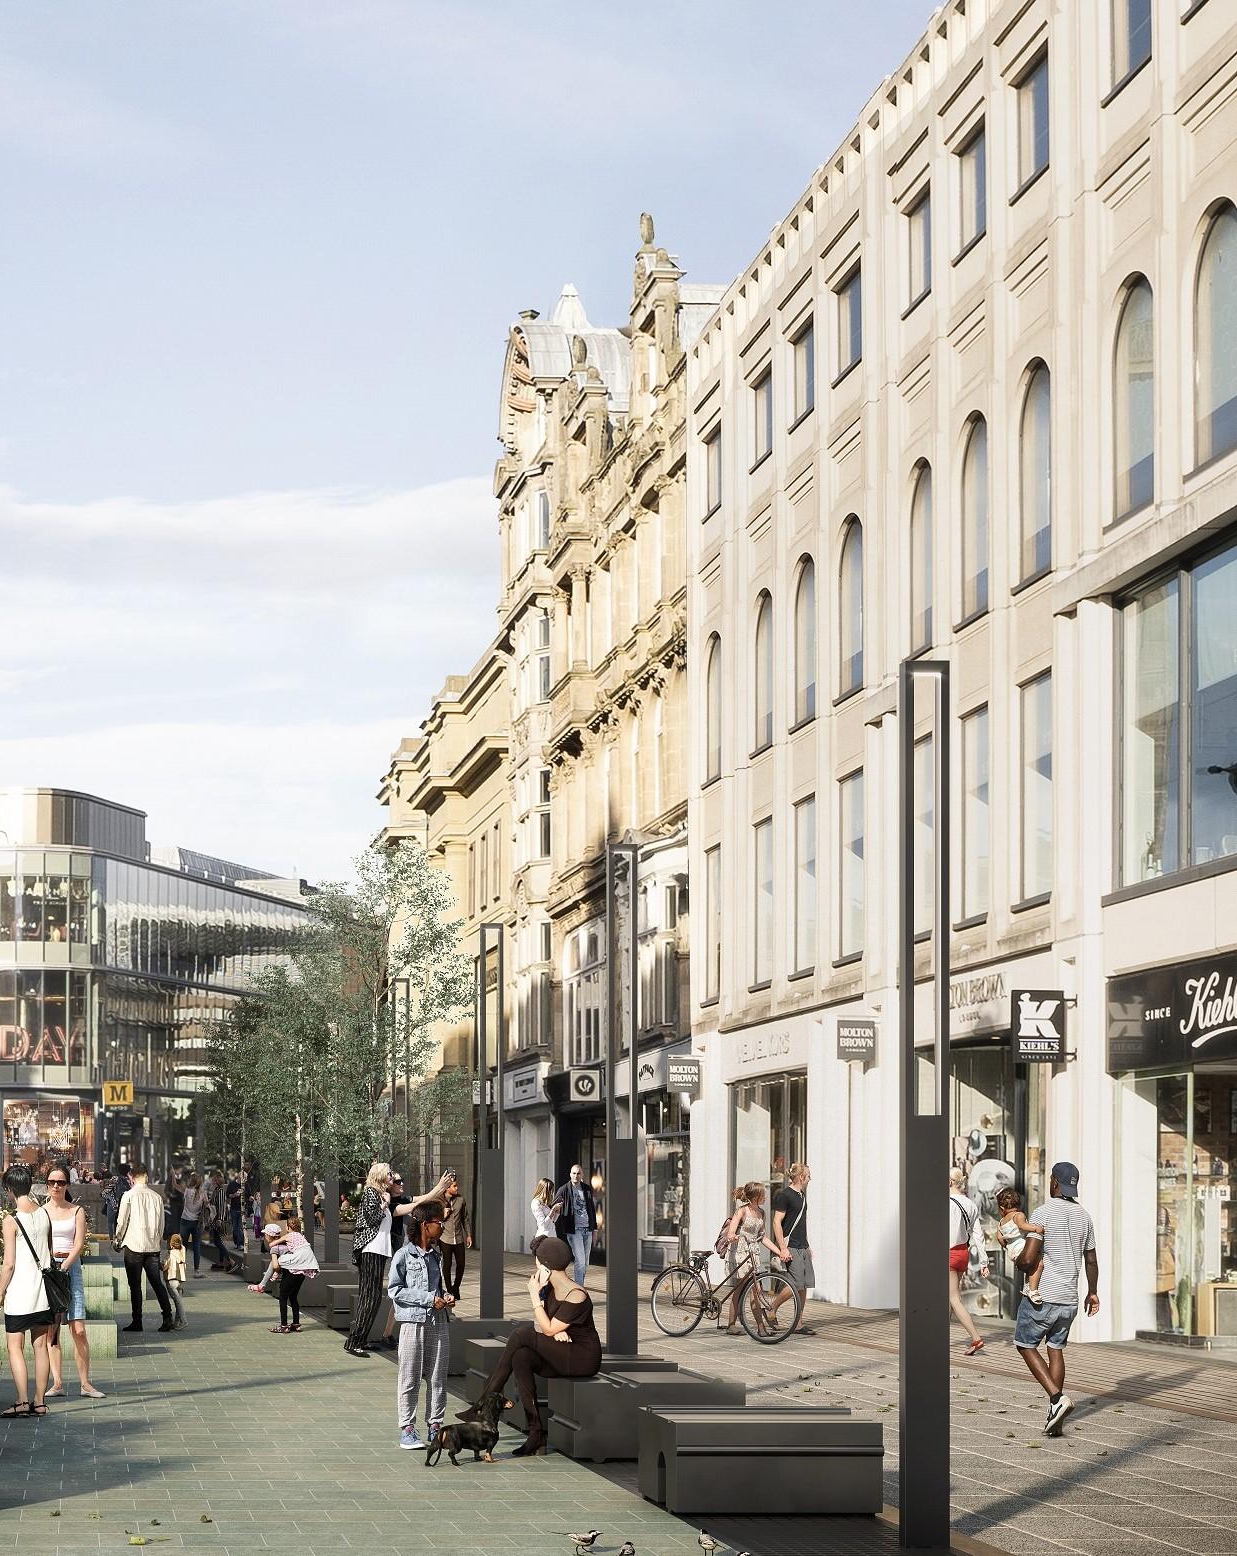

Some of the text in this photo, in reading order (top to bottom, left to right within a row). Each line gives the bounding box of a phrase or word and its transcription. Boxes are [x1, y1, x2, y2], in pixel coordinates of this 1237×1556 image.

[1144, 1006, 1172, 1021] SINCE
[839, 1027, 874, 1038] MOLTON
[839, 1037, 874, 1048] BROWN
[1019, 1041, 1060, 1051] KIEHL'S
[669, 1064, 699, 1074] MOLTON
[669, 1073, 699, 1083] BROWN
[109, 1085, 127, 1102] M
